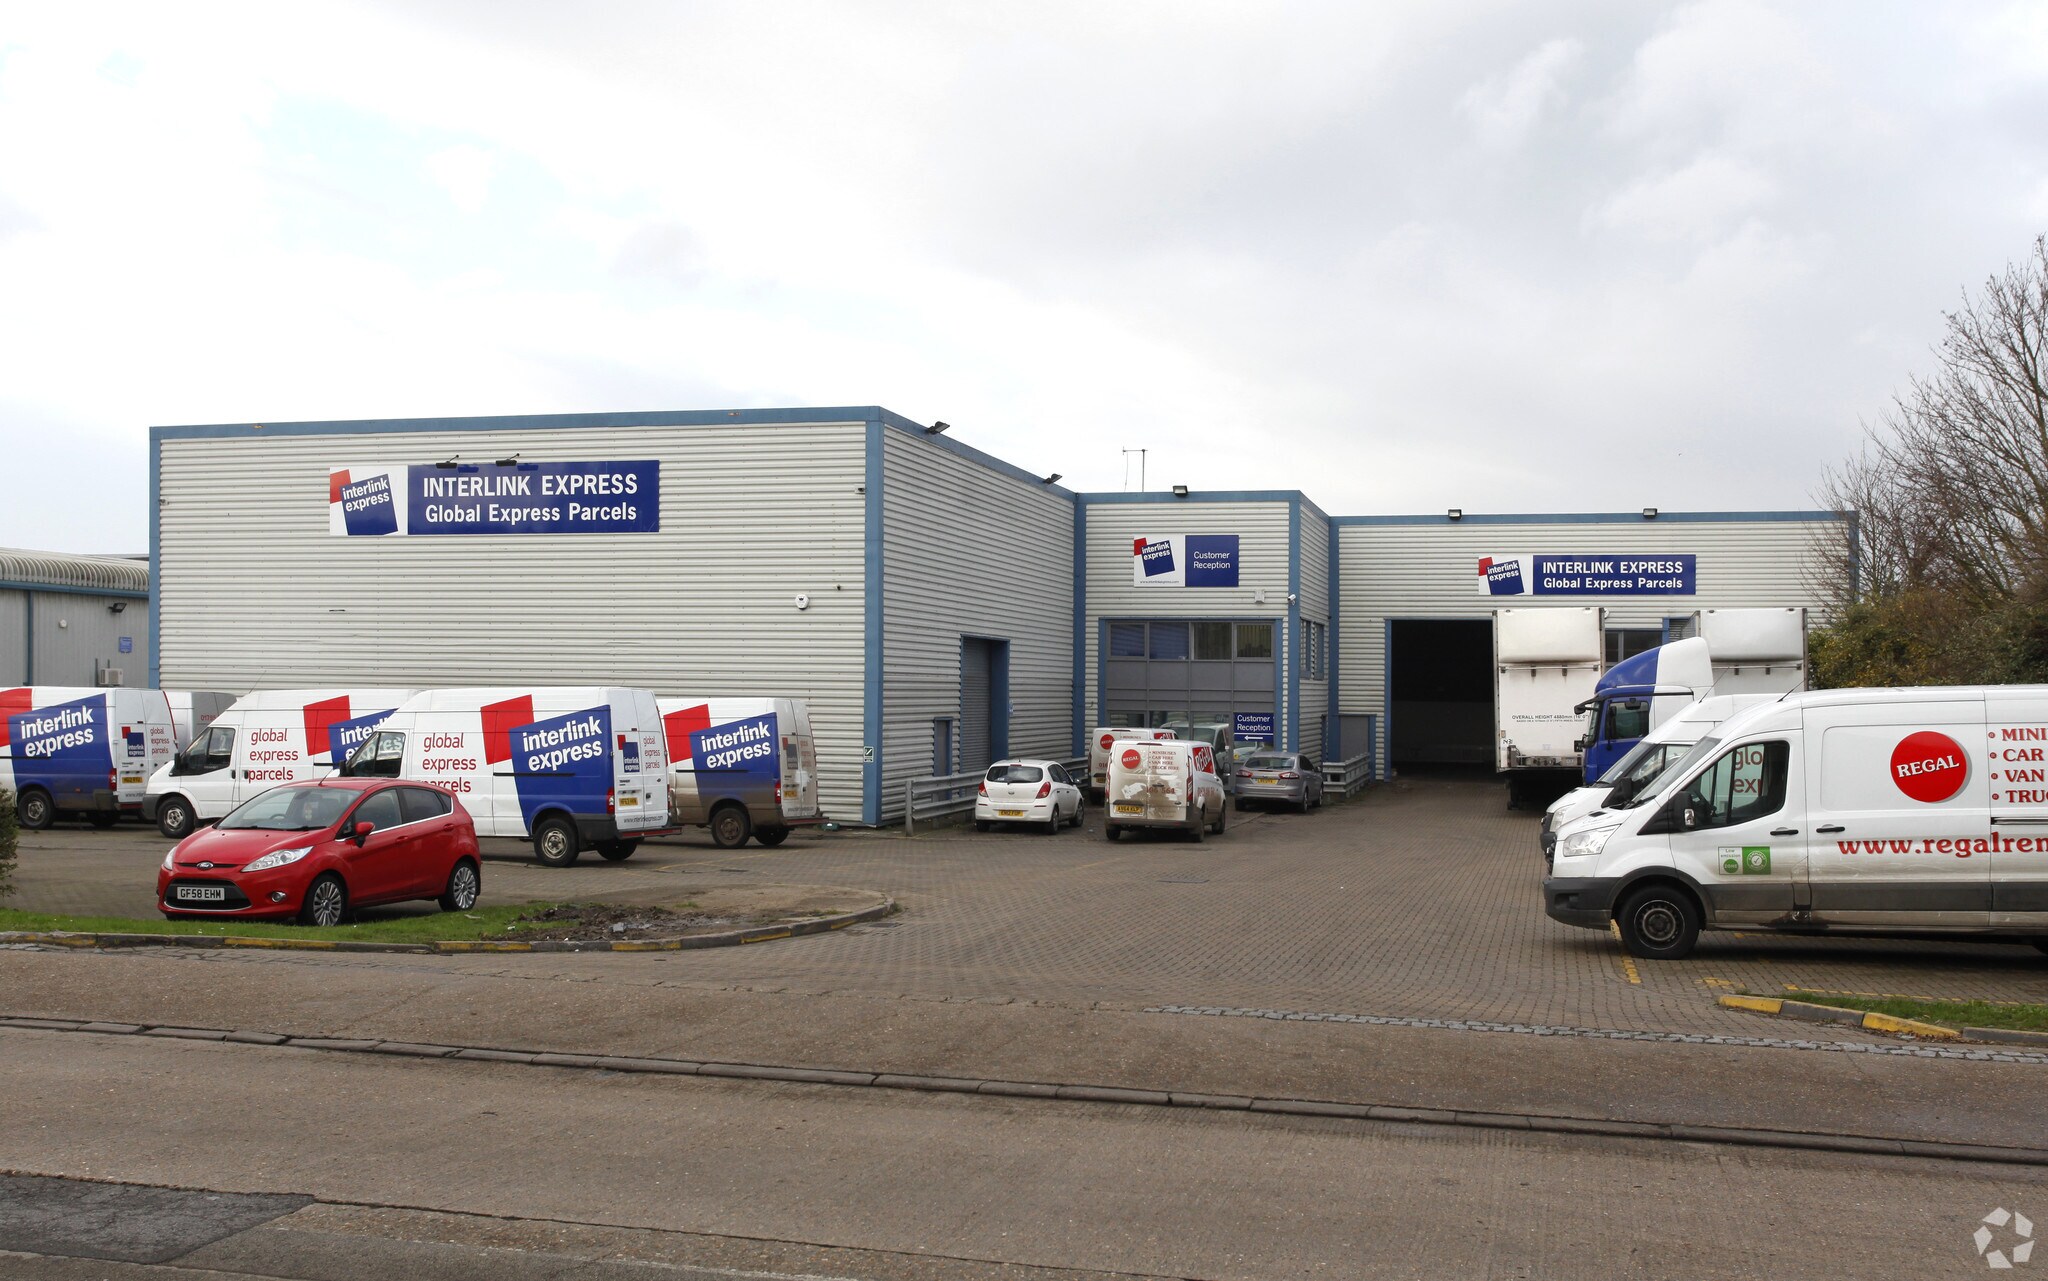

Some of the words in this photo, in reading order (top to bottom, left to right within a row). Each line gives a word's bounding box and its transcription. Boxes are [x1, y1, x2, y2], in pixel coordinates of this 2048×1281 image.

[342, 477, 389, 500] interlink
[423, 475, 531, 497] INTERLINK
[542, 473, 638, 496] EXPRESS
[345, 492, 390, 512] express
[425, 504, 480, 522] Global
[489, 503, 560, 525] Express
[569, 502, 637, 521] Parcels
[1141, 542, 1170, 554] interlink
[1143, 549, 1170, 560] express
[1193, 551, 1230, 559] Customer
[1193, 561, 1230, 570] Reception
[1487, 562, 1519, 575] interlink
[1543, 561, 1614, 574] INTERLINK
[1620, 561, 1683, 574] EXPRESS
[1489, 569, 1519, 582] express
[1543, 578, 1581, 588] Global
[1585, 577, 1633, 591] Express
[1638, 577, 1682, 588] Parcels
[20, 705, 94, 740] interlink
[1237, 714, 1270, 722] Customer
[150, 728, 164, 736] global
[522, 715, 602, 752] interlink
[1237, 723, 1271, 732] Reception
[25, 728, 94, 757] express
[251, 728, 287, 746] global
[423, 732, 464, 752] global
[643, 736, 655, 746] global
[701, 721, 771, 752] interlink
[151, 747, 169, 755] parcels
[249, 750, 298, 764] express
[528, 740, 602, 771] express
[706, 741, 771, 768] express
[2003, 748, 2045, 762] CAR
[422, 758, 477, 774] express
[1896, 755, 1960, 778] REGAL
[248, 766, 294, 784] parcels
[2004, 769, 2045, 782] VAN
[2005, 789, 2048, 803] TRU
[180, 888, 203, 898] GF58
